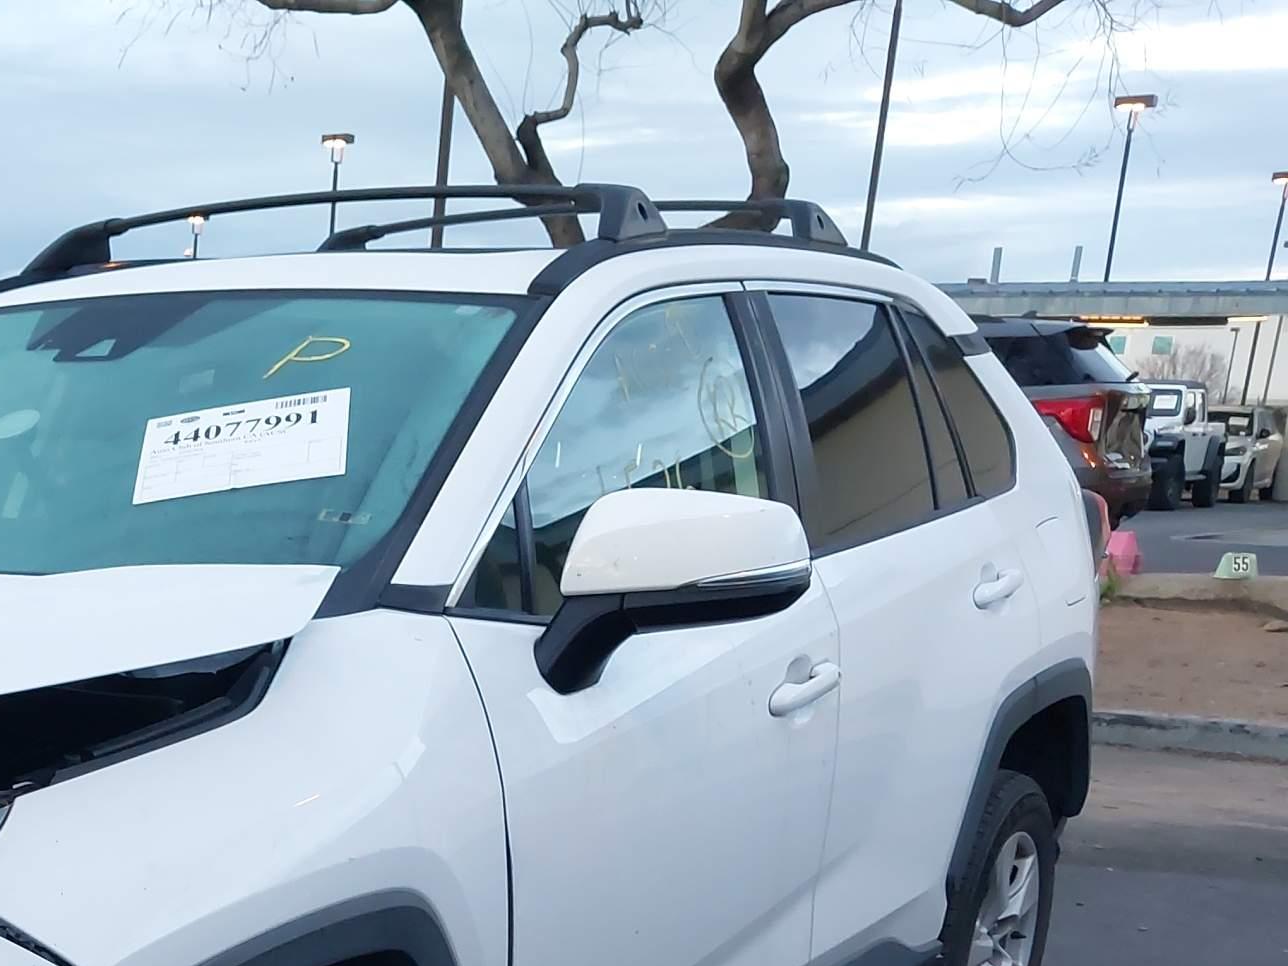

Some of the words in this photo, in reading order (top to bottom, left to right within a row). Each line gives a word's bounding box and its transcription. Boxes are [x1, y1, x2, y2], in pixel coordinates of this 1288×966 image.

[262, 335, 351, 380] P
[164, 409, 318, 446] 44077991
[1233, 556, 1249, 572] 55
